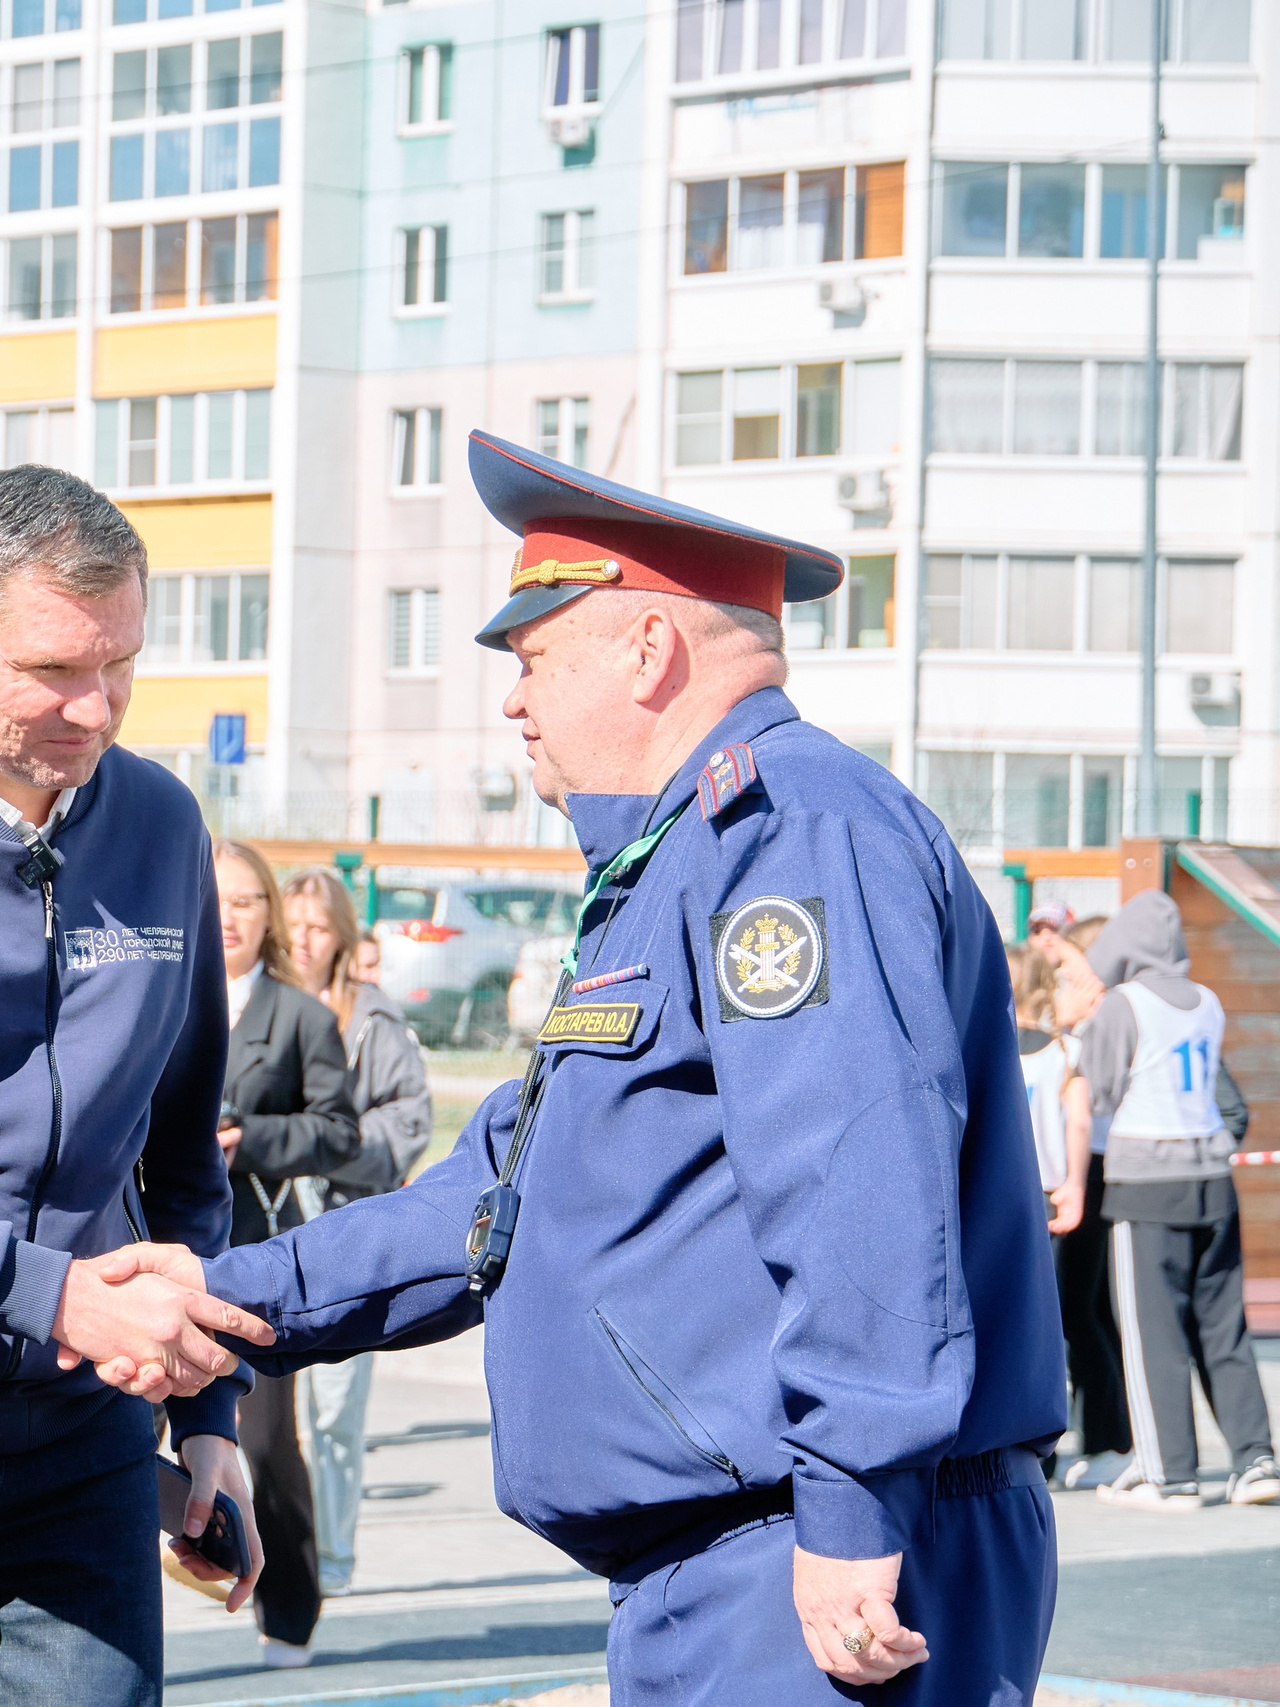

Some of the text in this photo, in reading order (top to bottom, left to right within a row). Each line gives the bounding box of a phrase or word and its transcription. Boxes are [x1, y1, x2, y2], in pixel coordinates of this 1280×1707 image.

[94, 930, 119, 949] 30
[121, 927, 139, 937] ЛЕТ
[123, 937, 171, 949] ГОРОДСКОЙ
[97, 947, 126, 964] 290
[126, 949, 145, 961] ЛЕТ
[545, 1011, 628, 1034] КОСТАРЕВ Ю.А.
